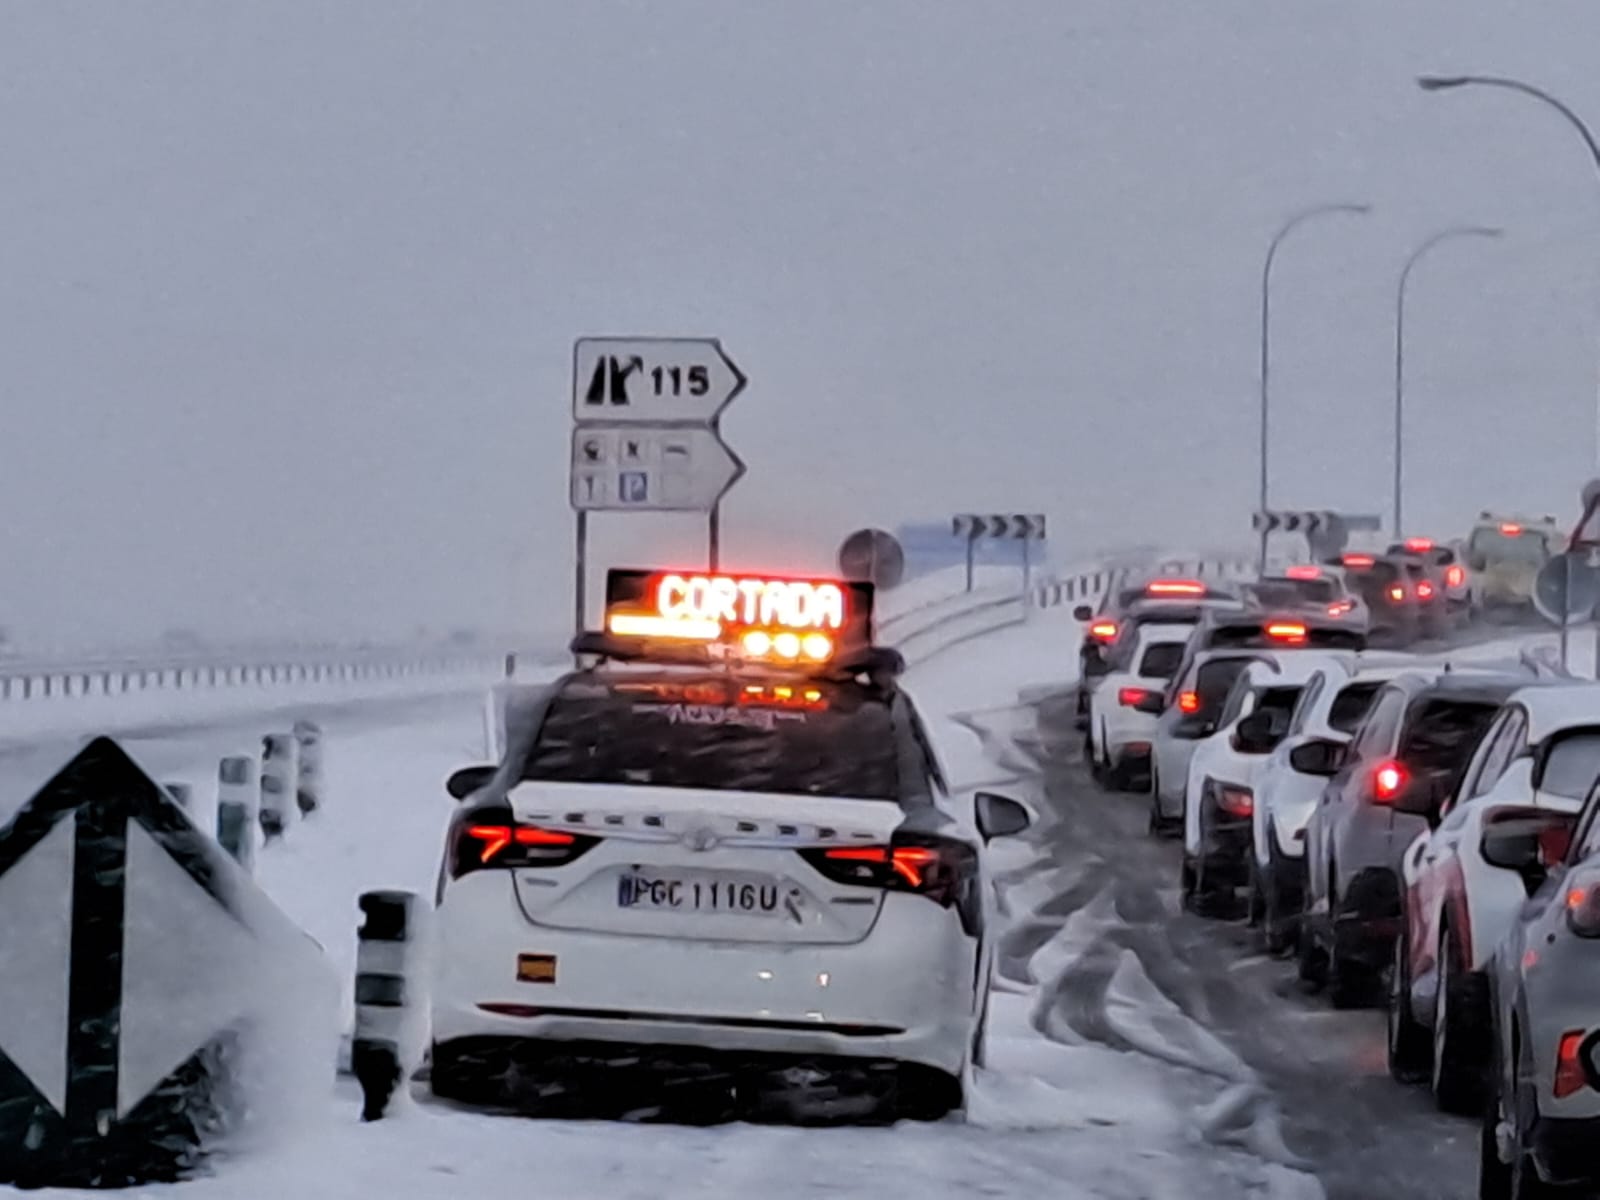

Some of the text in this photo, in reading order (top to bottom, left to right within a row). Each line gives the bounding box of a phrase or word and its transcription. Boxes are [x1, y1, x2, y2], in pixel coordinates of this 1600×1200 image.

[651, 365, 709, 396] 115
[657, 574, 842, 629] CORTADA
[632, 878, 683, 907] PGC
